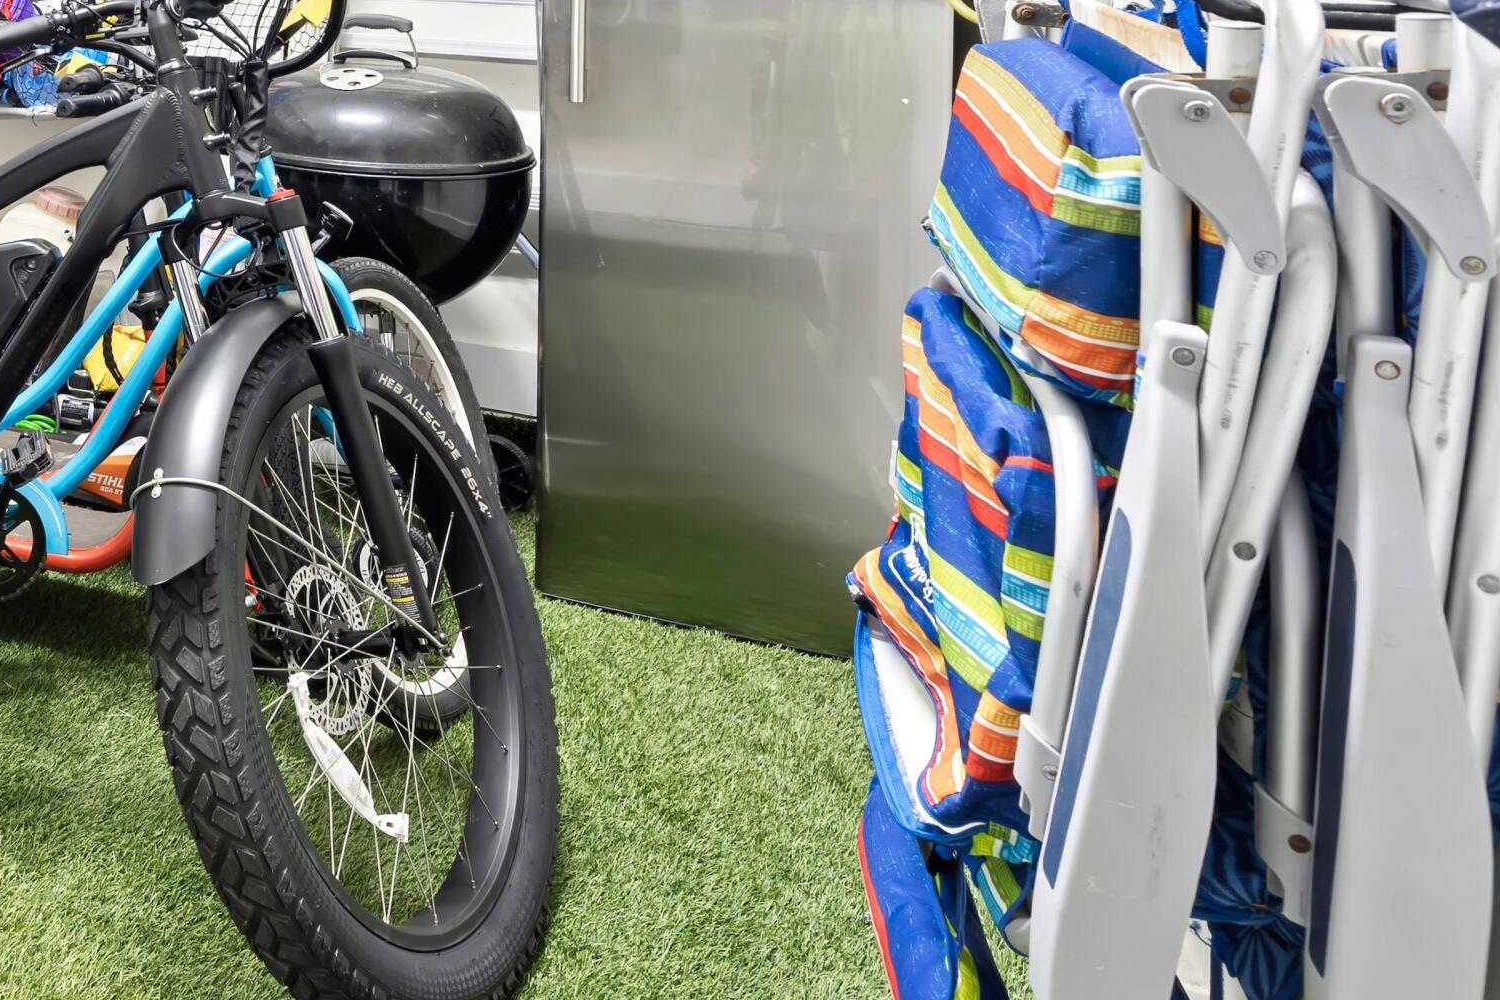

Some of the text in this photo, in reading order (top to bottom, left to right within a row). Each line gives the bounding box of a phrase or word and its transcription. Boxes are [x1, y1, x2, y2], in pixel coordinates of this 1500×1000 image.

[378, 373, 403, 395] HEB
[403, 392, 462, 461] ALLSCAPE
[86, 472, 124, 489] STIHL
